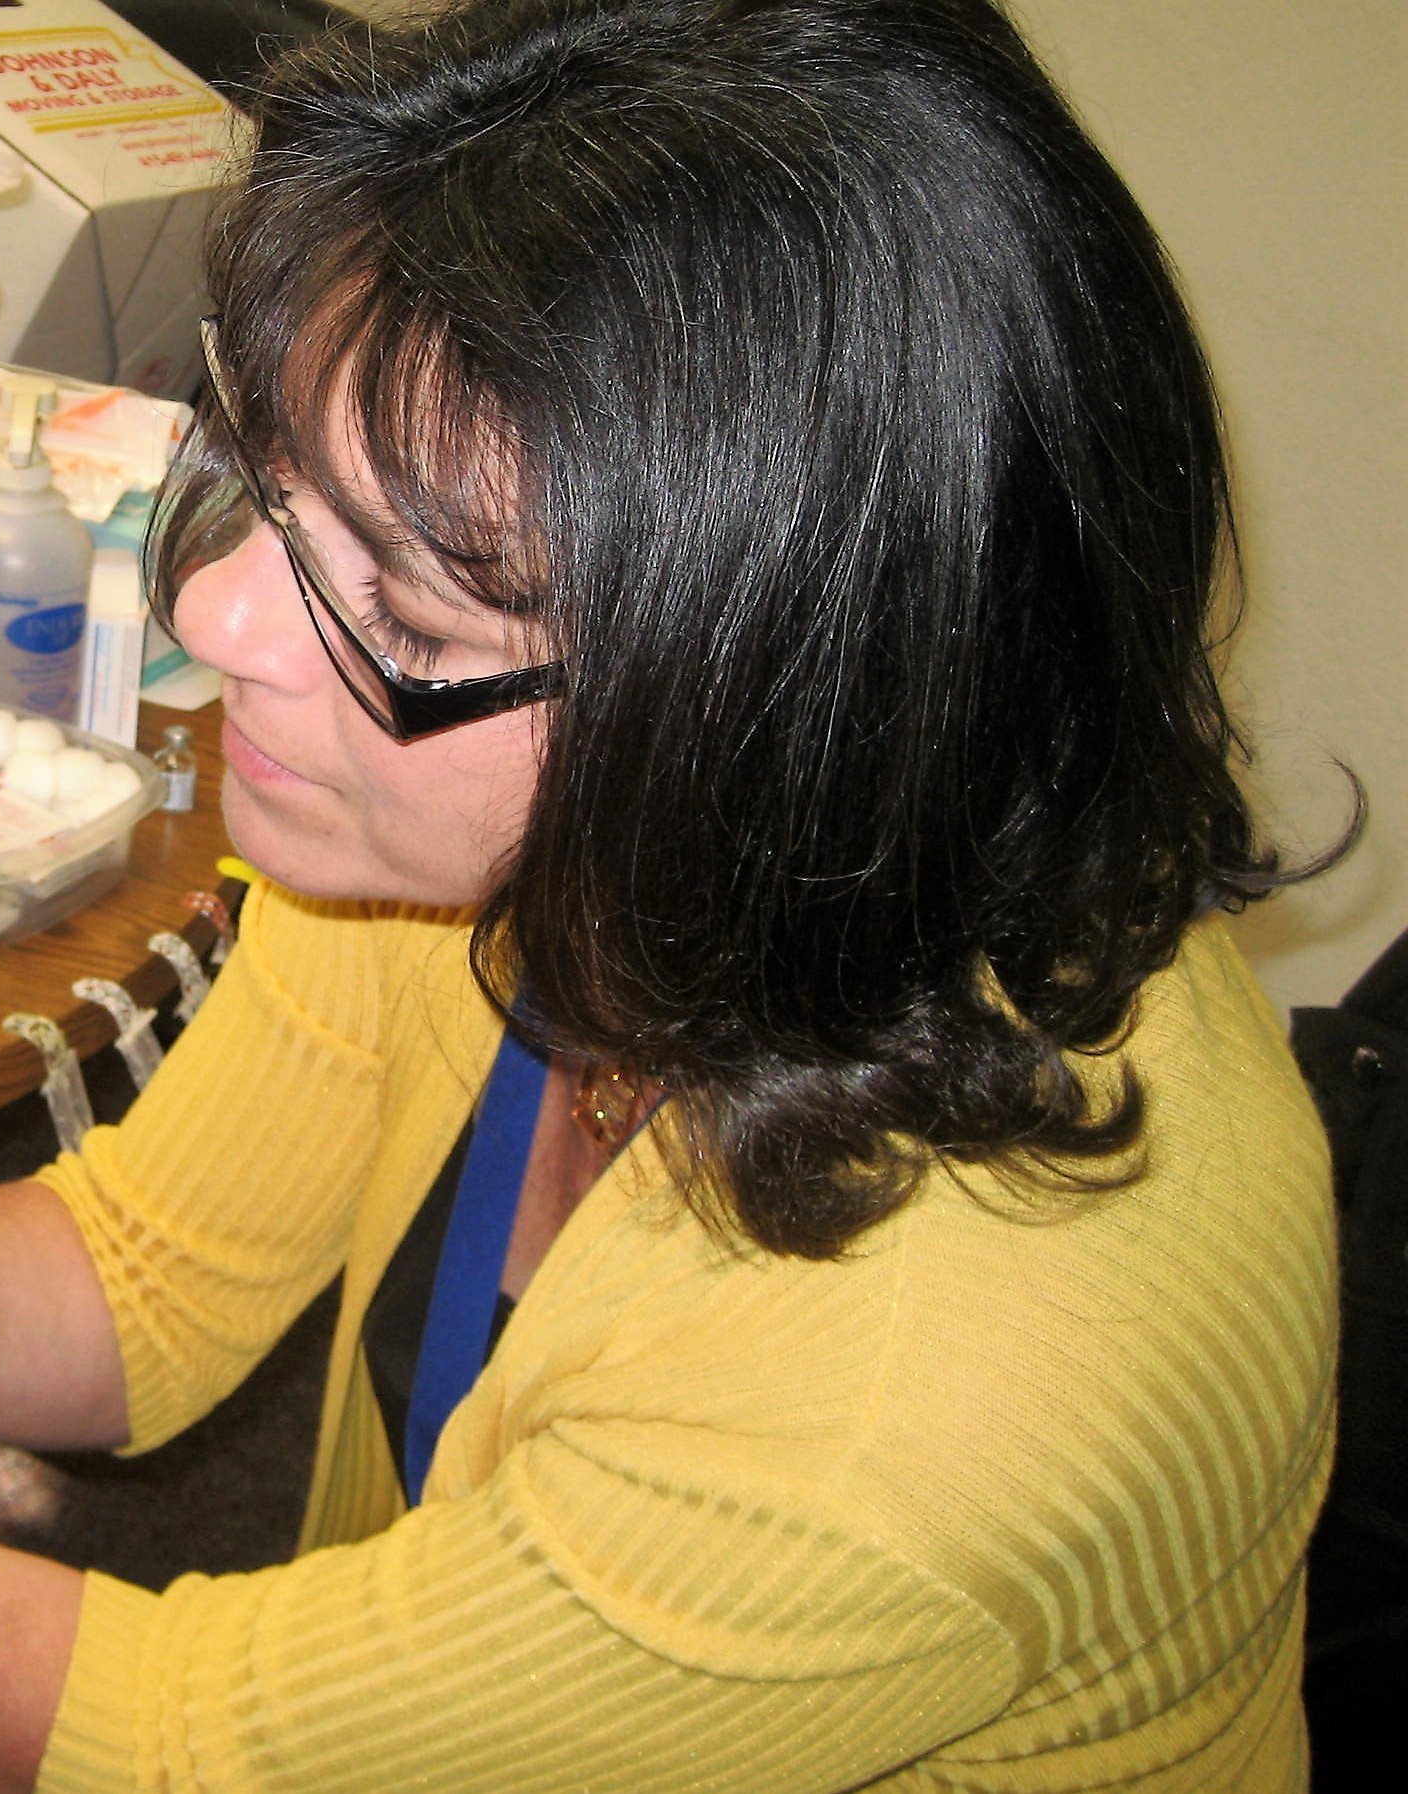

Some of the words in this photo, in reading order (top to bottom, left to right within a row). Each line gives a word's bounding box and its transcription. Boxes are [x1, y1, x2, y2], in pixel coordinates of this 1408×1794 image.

[30, 75, 55, 92] &
[52, 68, 124, 91] DALY
[6, 94, 86, 113] MOVING
[102, 84, 184, 103] STORAGE
